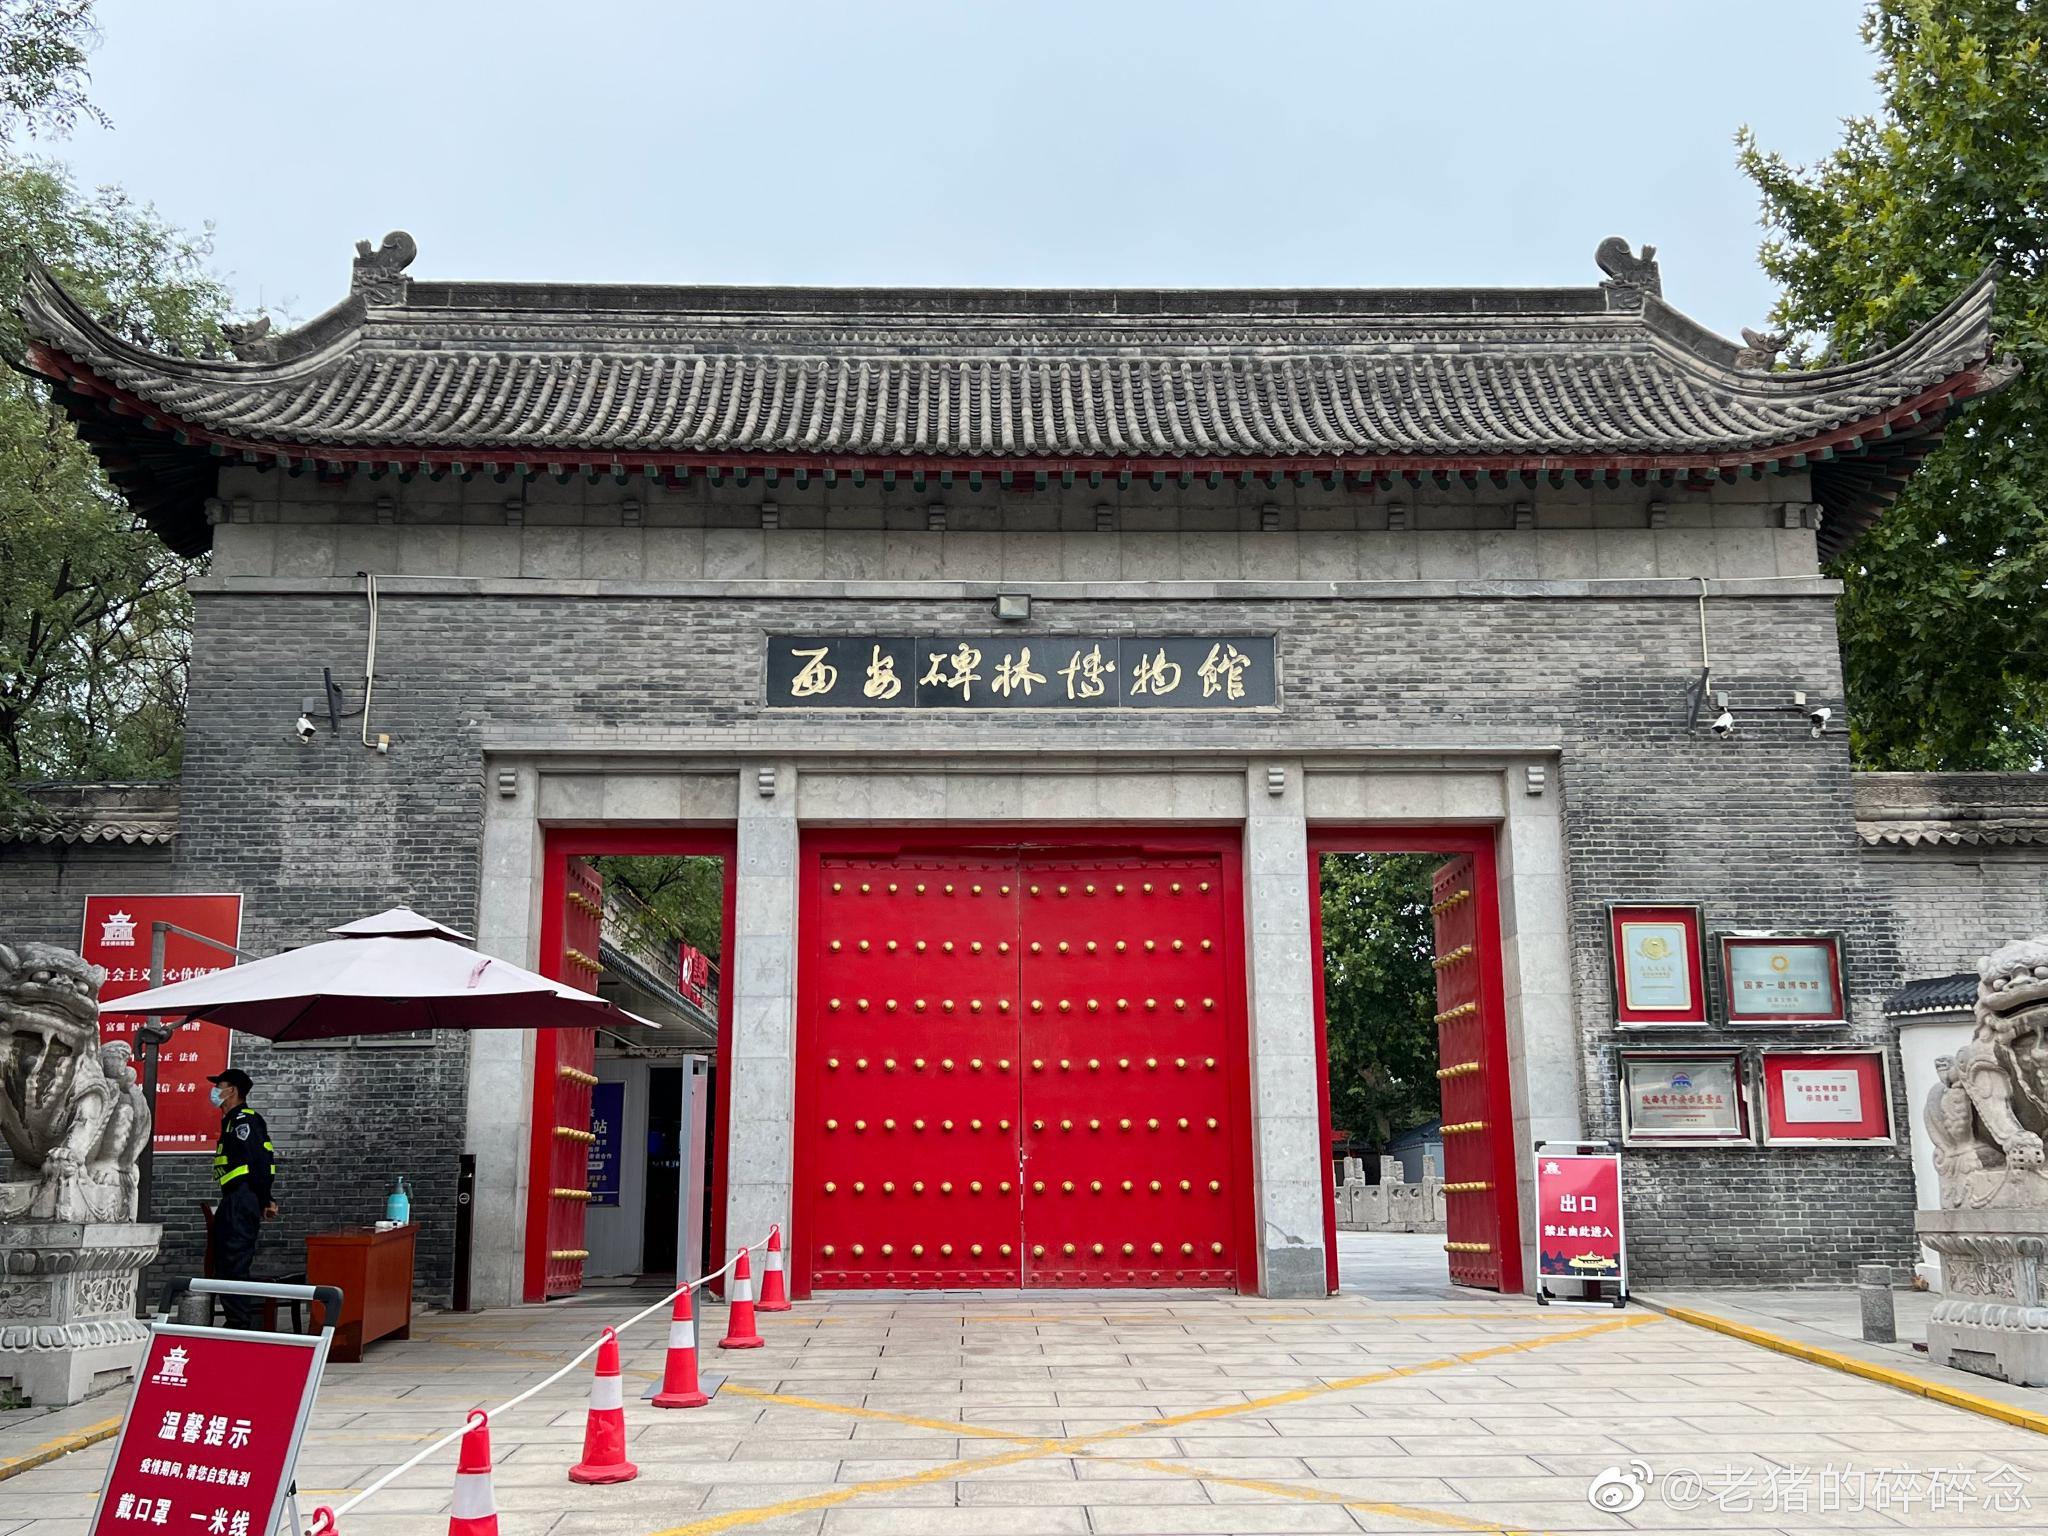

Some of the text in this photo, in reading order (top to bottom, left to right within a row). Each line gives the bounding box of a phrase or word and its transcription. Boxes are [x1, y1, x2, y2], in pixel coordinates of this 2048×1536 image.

[1560, 1194, 1597, 1213] 出口
[1544, 1224, 1614, 1238] 禁止由此进入
[158, 1410, 252, 1449] 温馨提示
[115, 1493, 251, 1536] 戴口罩 一米线
